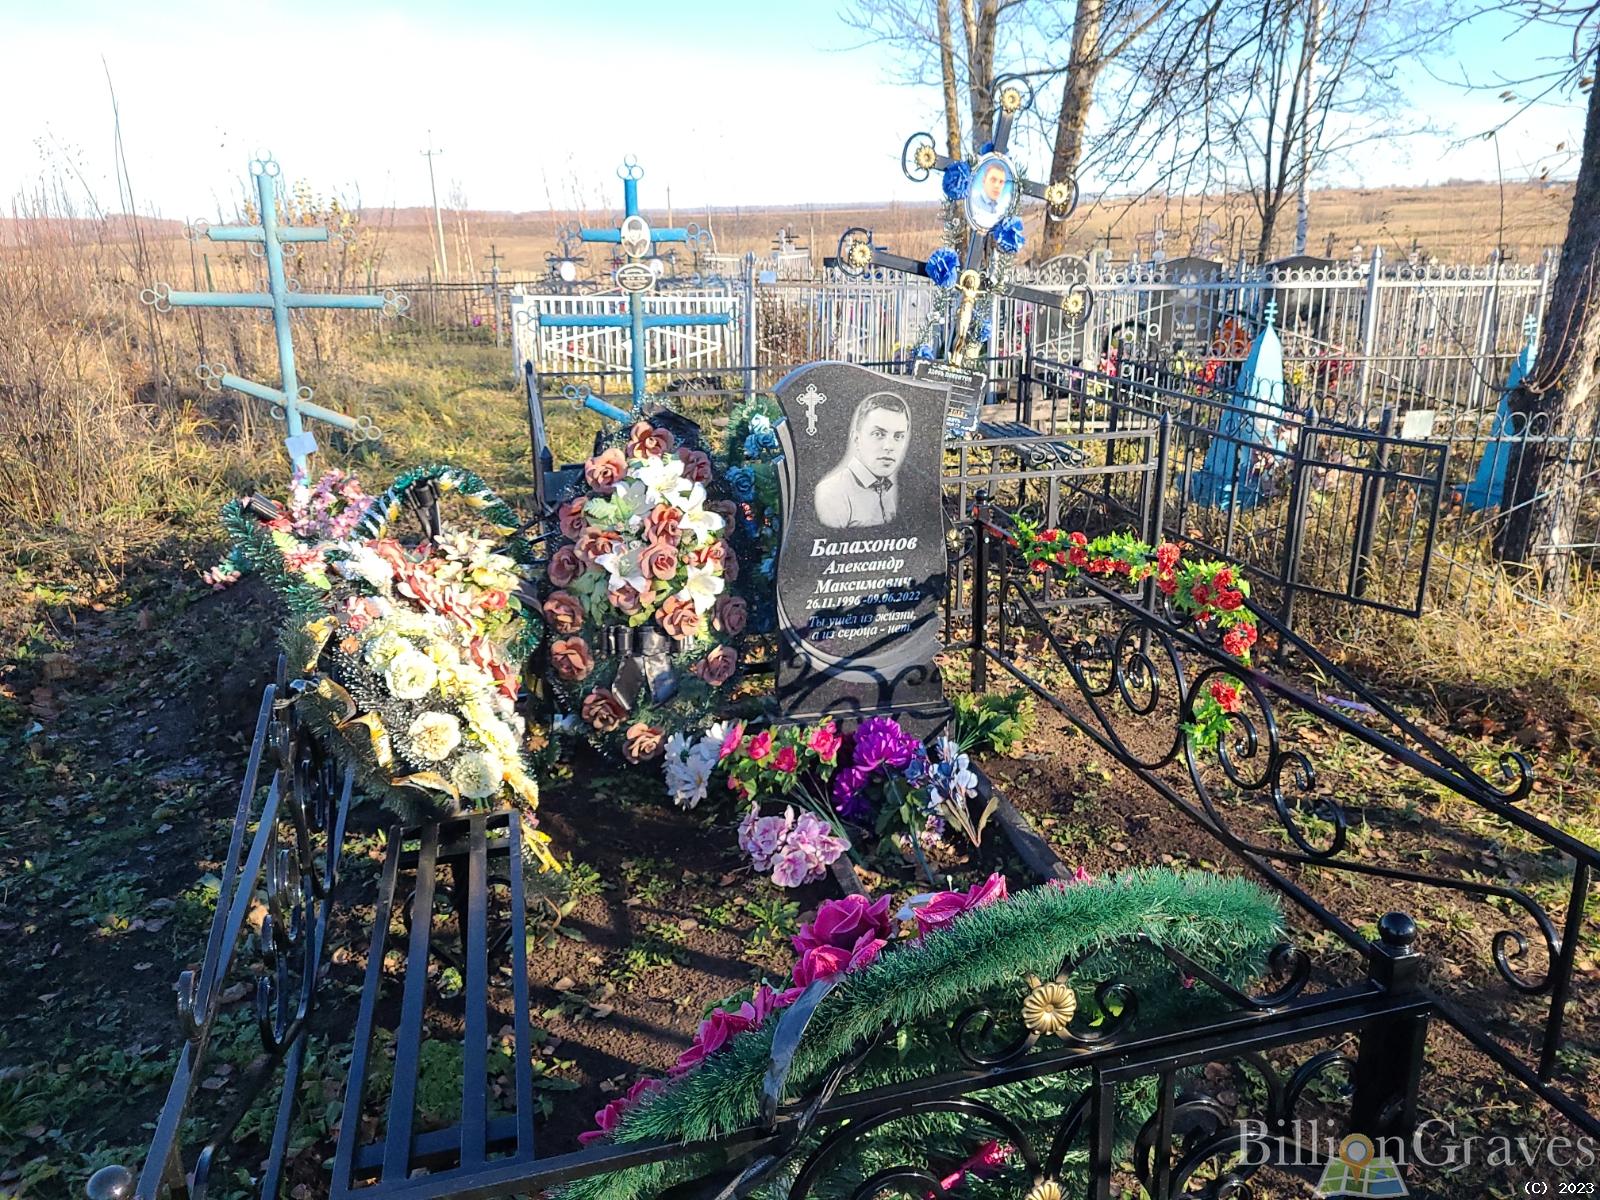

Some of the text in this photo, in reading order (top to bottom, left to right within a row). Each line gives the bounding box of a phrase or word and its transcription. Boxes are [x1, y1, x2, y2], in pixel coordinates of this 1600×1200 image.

[810, 536, 918, 557] Балахонов
[822, 556, 905, 575] Александр
[814, 576, 912, 594] Максимович
[805, 595, 861, 610] 26.11.1996
[809, 610, 917, 630] Ты ушёл из жизни,
[811, 631, 820, 640] а
[822, 630, 835, 640] из
[837, 624, 878, 641] сердца
